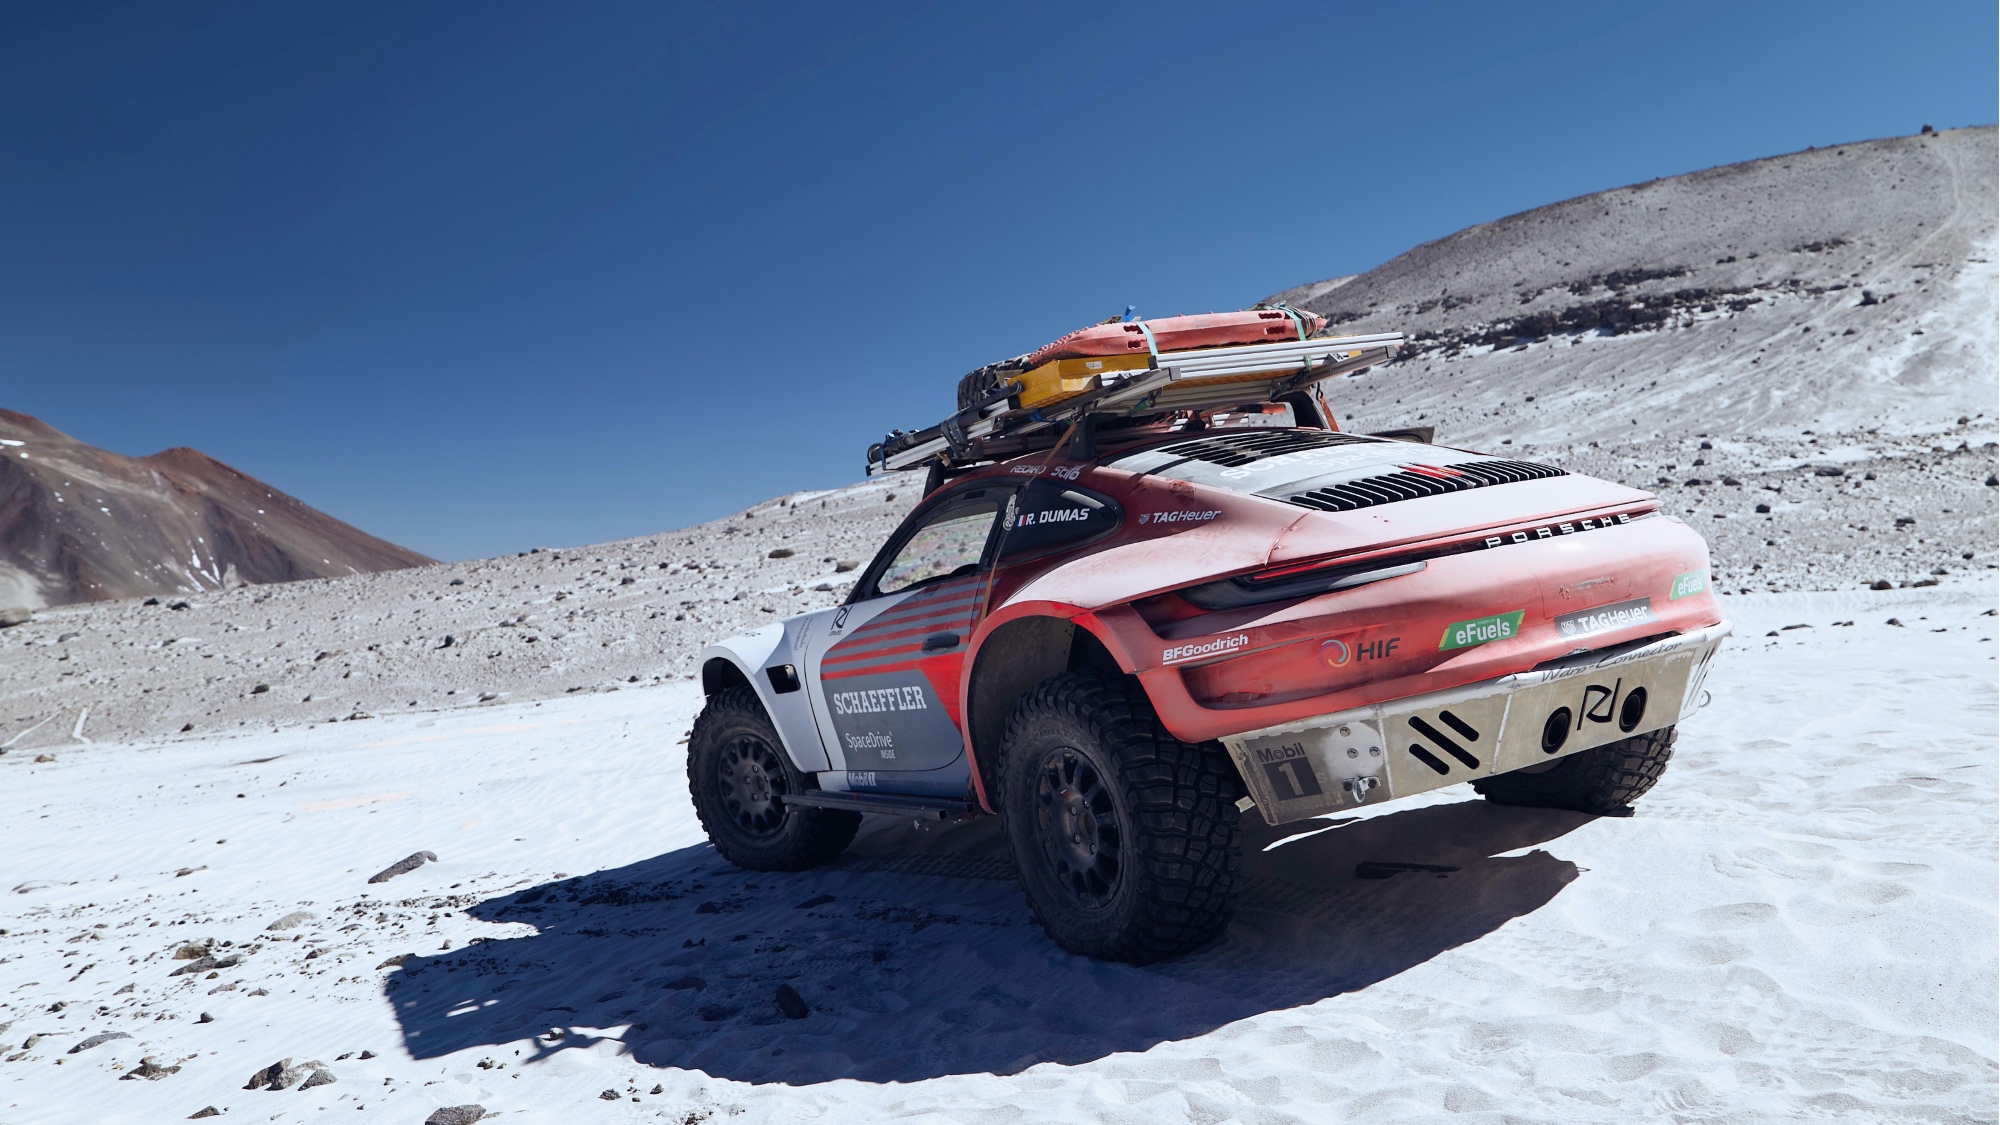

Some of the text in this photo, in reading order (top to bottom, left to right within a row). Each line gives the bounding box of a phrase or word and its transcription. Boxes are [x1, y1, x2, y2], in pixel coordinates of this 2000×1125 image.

[1025, 507, 1090, 526] R. DUMAS
[1485, 513, 1631, 549] PORSCHE
[1677, 575, 1703, 596] eFuels
[1456, 618, 1511, 645] eFuels
[1163, 634, 1249, 661] BFGoodrich
[1356, 637, 1400, 662] HIF
[833, 685, 927, 715] SCHAEFFLER
[880, 749, 896, 759] INSIDE
[1256, 742, 1306, 762] Mobil
[848, 772, 868, 786] Mobil
[1278, 762, 1304, 796] 1
